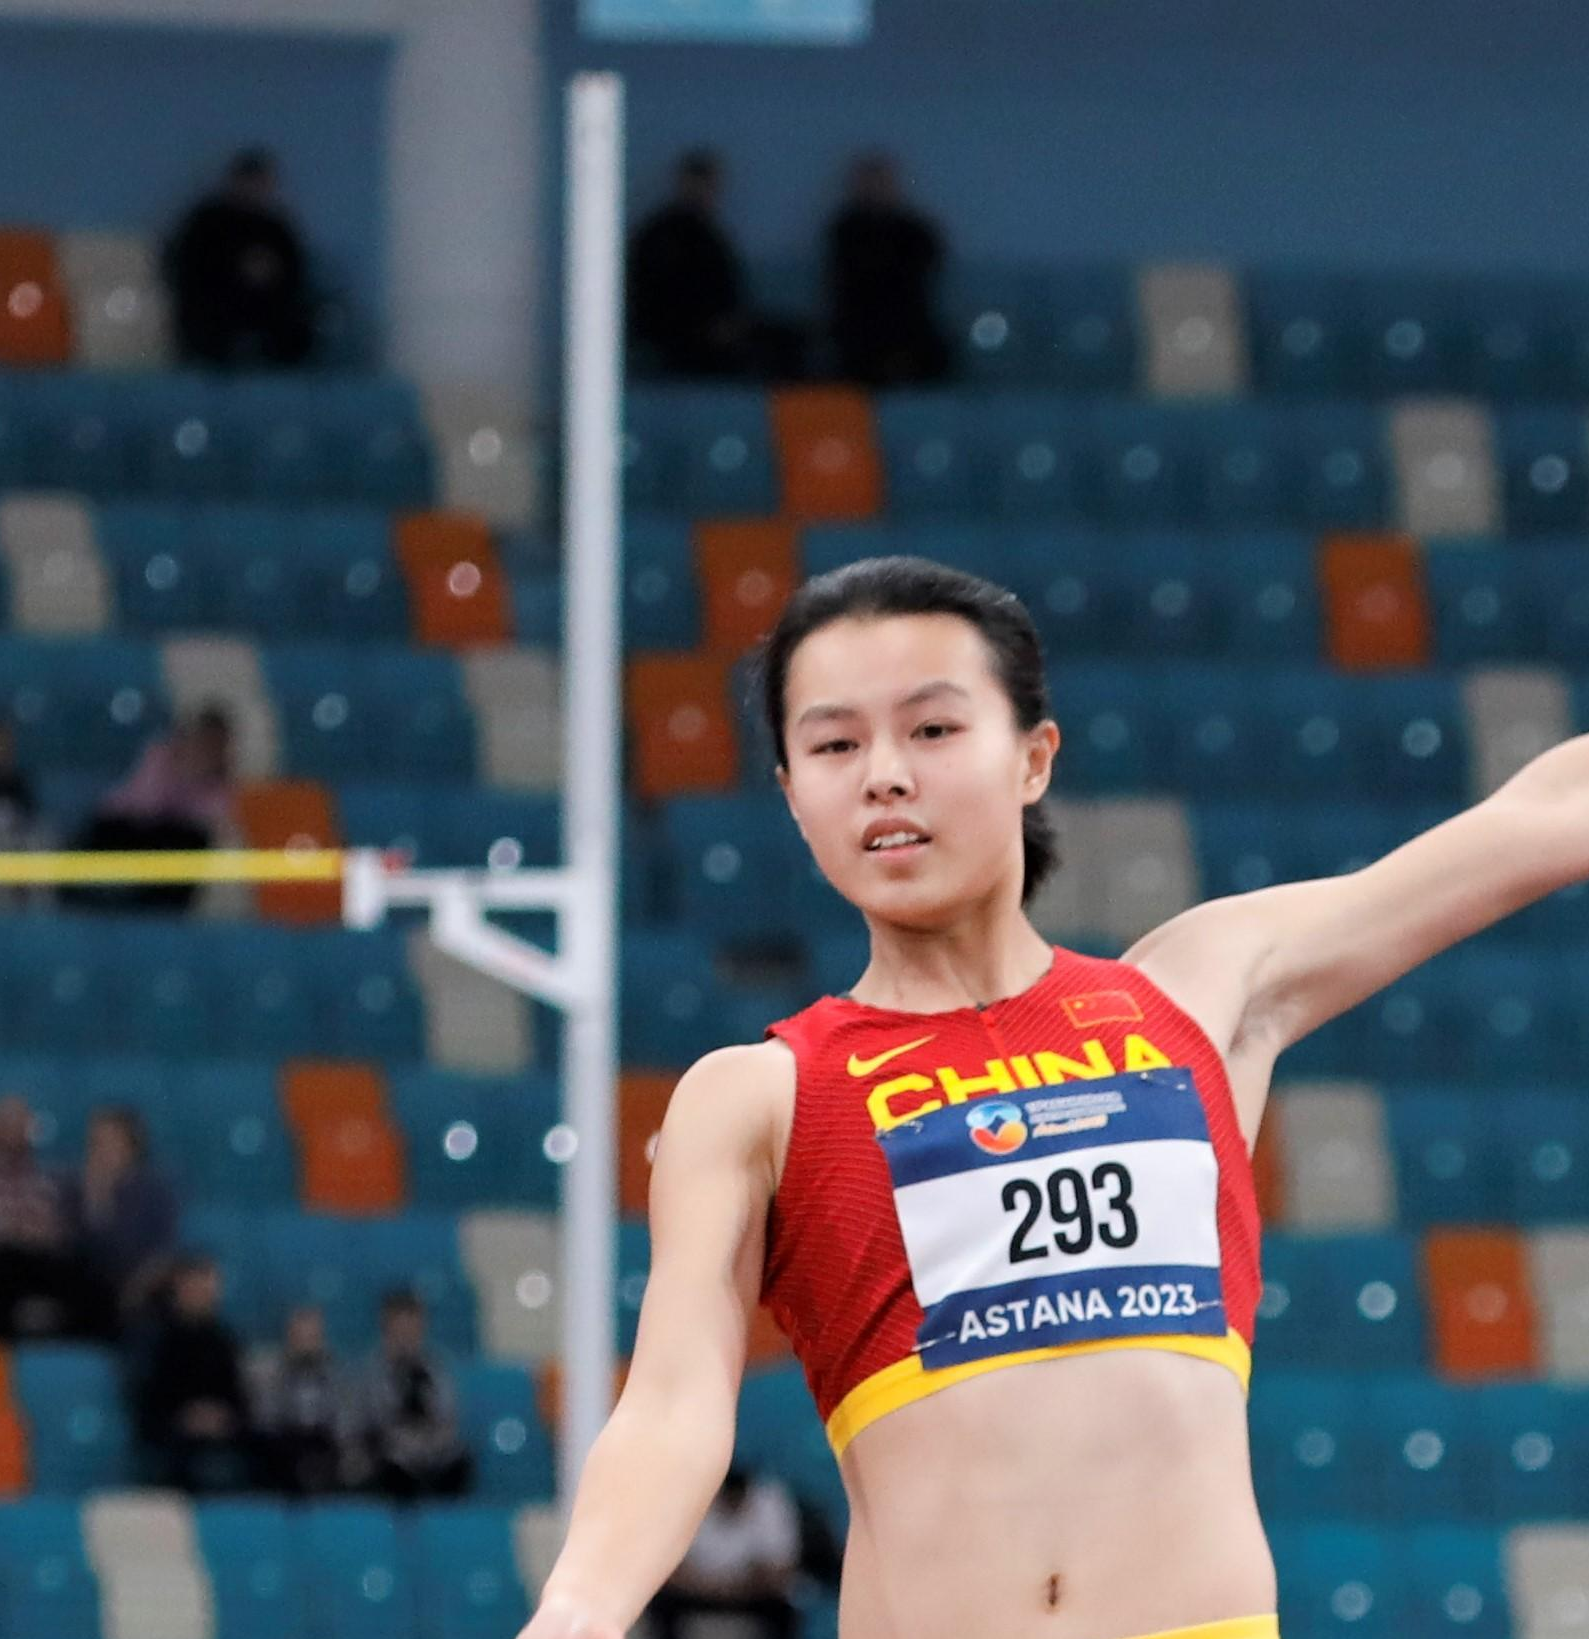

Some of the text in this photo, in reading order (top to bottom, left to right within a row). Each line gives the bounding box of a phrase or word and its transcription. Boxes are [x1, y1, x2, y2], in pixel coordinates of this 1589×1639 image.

[866, 1033, 1172, 1132] CHINA
[1001, 1162, 1139, 1266] 293
[958, 1283, 1198, 1345] ASTANA 2023
